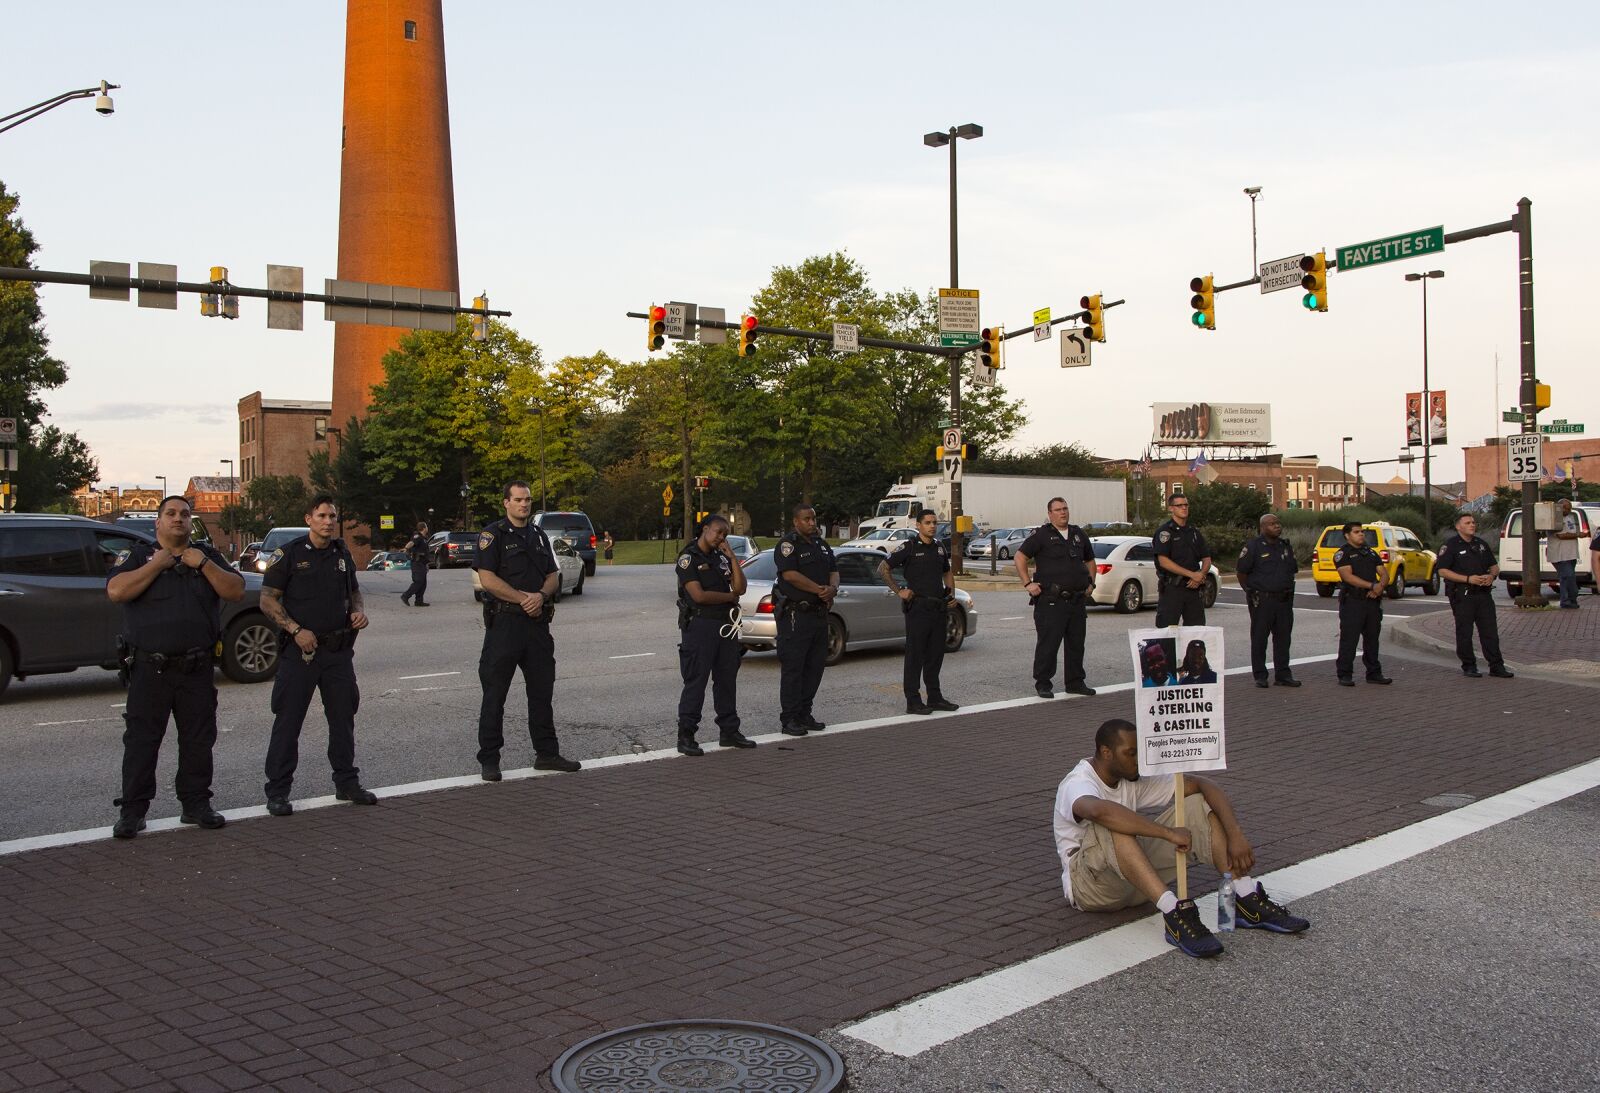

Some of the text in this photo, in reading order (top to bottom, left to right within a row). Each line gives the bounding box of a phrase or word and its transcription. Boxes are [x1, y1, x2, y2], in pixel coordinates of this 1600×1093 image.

[1344, 235, 1436, 267] FAYETTE ST.
[1262, 267, 1269, 277] DO
[1271, 263, 1282, 274] NOT
[1264, 272, 1302, 289] INTERSECTION
[670, 307, 680, 316] NO
[1065, 355, 1087, 365] ONLY
[975, 375, 993, 384] ONLY
[1510, 436, 1538, 446] SPEED
[1512, 446, 1535, 454] LIMIT
[1512, 457, 1538, 474] 35
[1157, 688, 1203, 701] JUSTICE!
[1149, 702, 1213, 716] 4 STERLING
[1153, 718, 1210, 732] & CASTILE
[1148, 735, 1217, 748] Peoples Power Assembly
[1160, 748, 1202, 758] 443-221-3775
